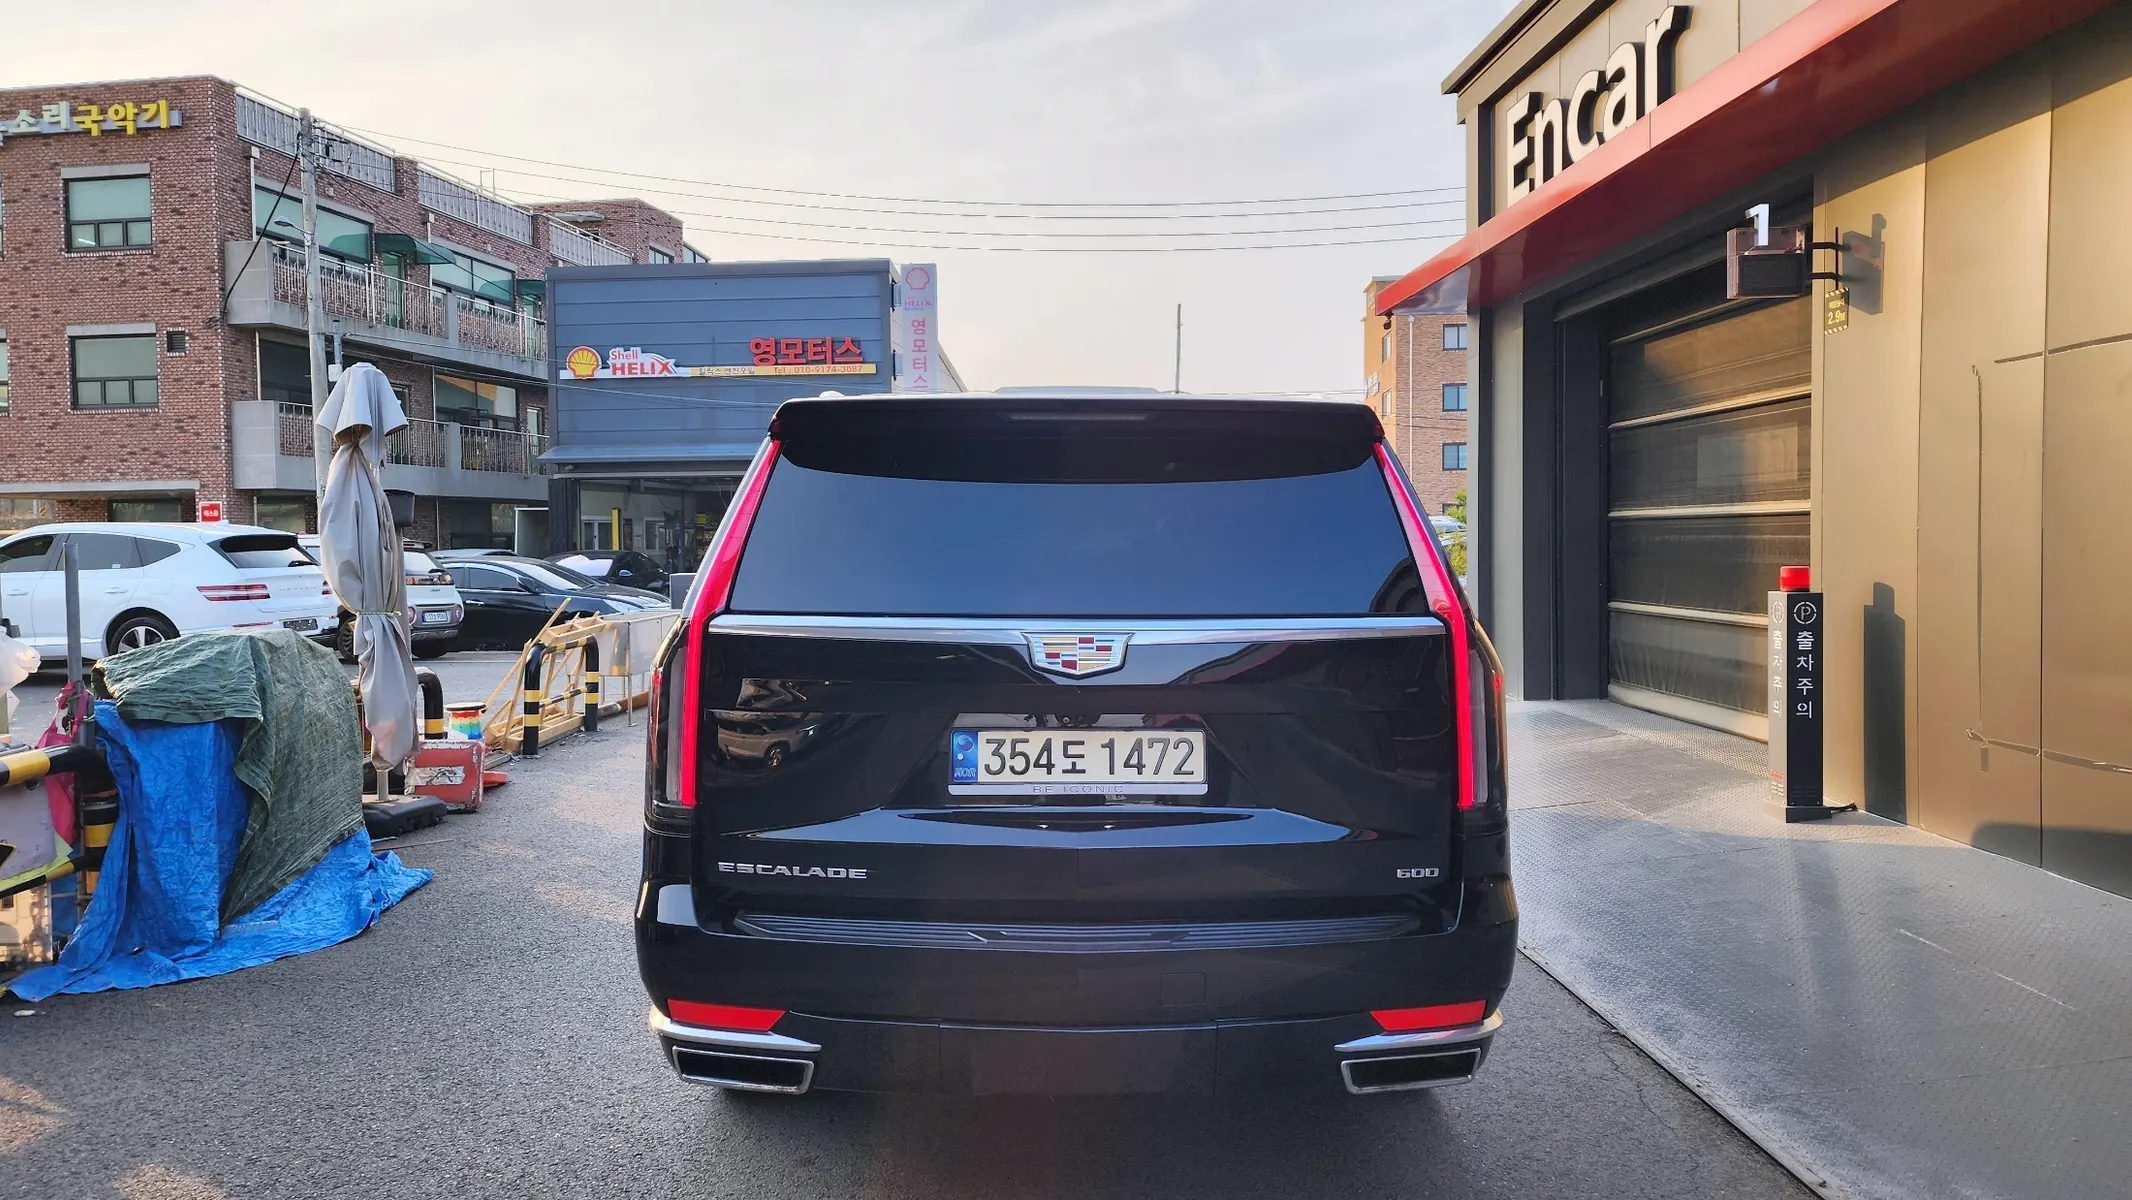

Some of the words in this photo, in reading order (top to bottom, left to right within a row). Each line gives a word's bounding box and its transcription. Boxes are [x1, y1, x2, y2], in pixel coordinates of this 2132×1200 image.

[1507, 5, 1692, 208] Encar
[1745, 203, 1770, 246] 1
[611, 349, 638, 360] Shell
[749, 336, 864, 367] 영모터스
[911, 318, 928, 389] 영모터스
[611, 361, 675, 376] HELIX
[773, 366, 786, 374] Tel
[794, 365, 863, 374] 010-9174-3087
[1796, 630, 1815, 719] 출차주의
[984, 736, 1087, 776] 354도
[1099, 736, 1195, 776] 1472
[1032, 785, 1053, 794] BE
[1063, 785, 1124, 794] ICONIC
[717, 861, 868, 880] ESCALADE
[1396, 867, 1440, 879] 600
